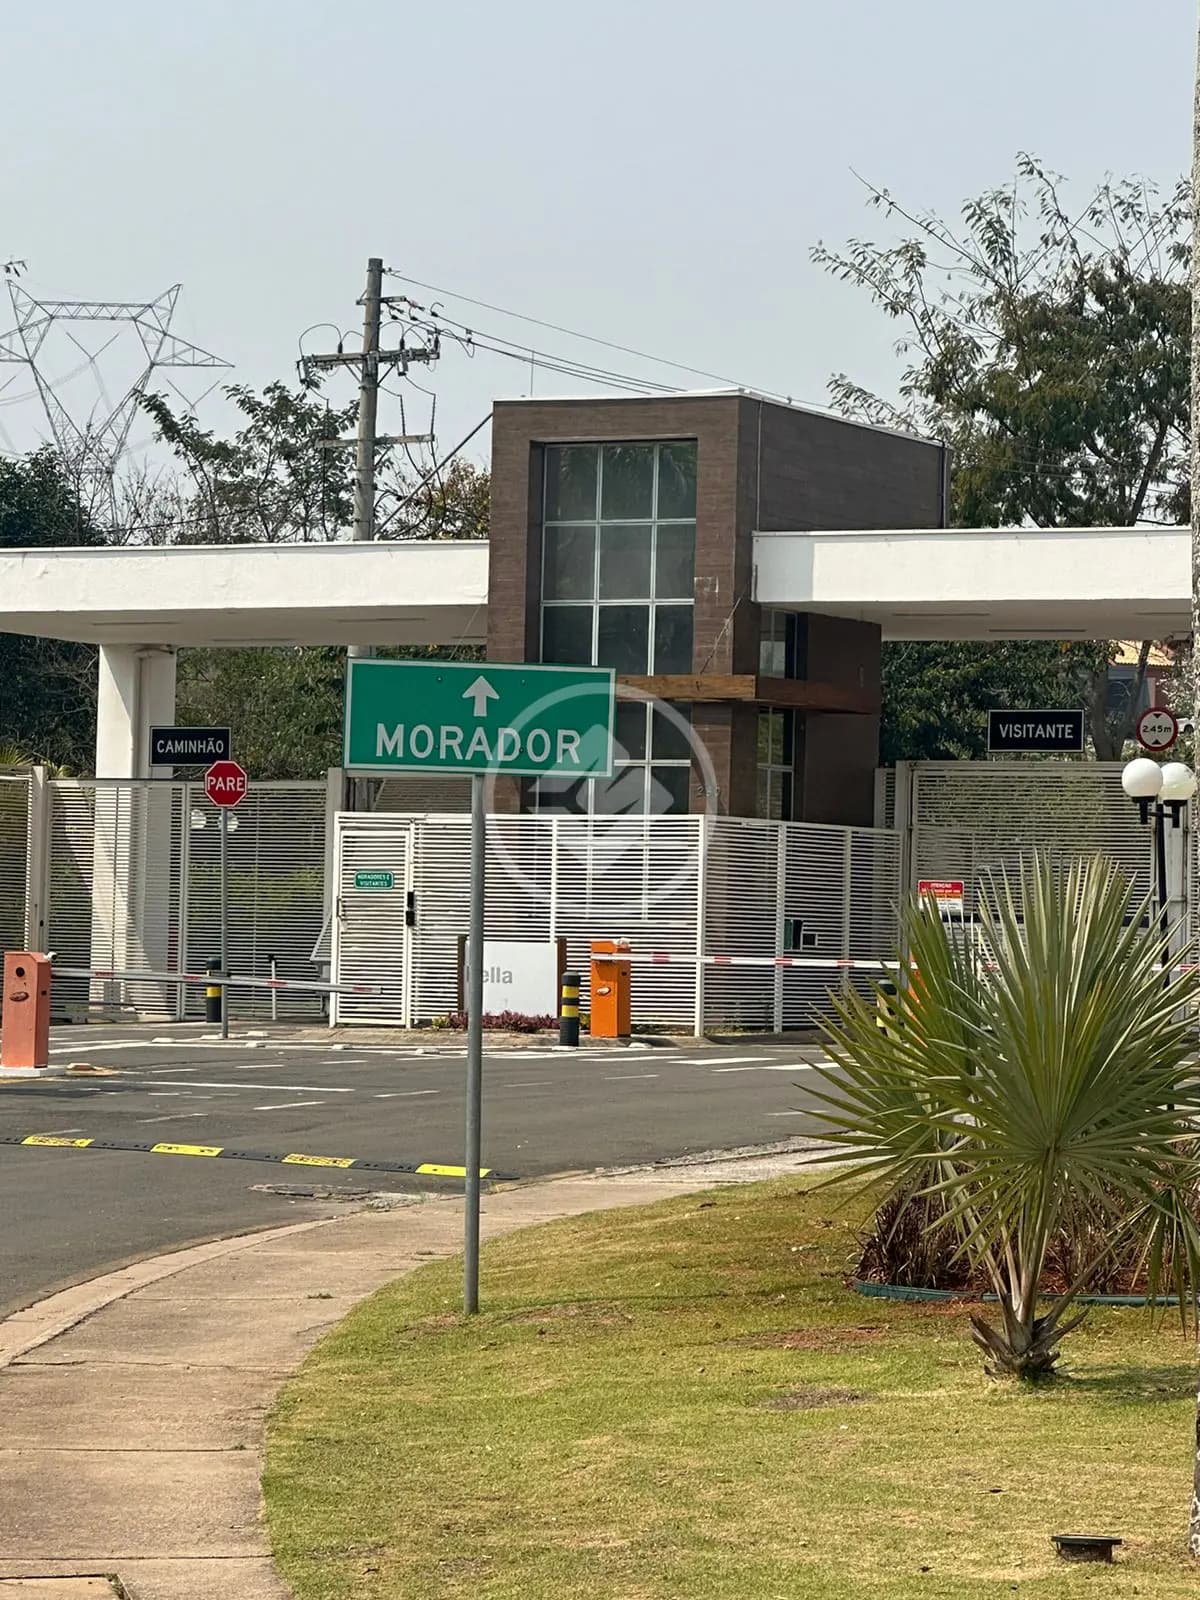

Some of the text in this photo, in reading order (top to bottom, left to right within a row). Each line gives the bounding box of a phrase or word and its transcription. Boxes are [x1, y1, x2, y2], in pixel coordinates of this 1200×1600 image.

[999, 723, 1074, 739] VISITANTE
[156, 737, 225, 754] CAMINHÃO
[375, 722, 581, 765] MORADOR
[207, 776, 245, 791] PARE
